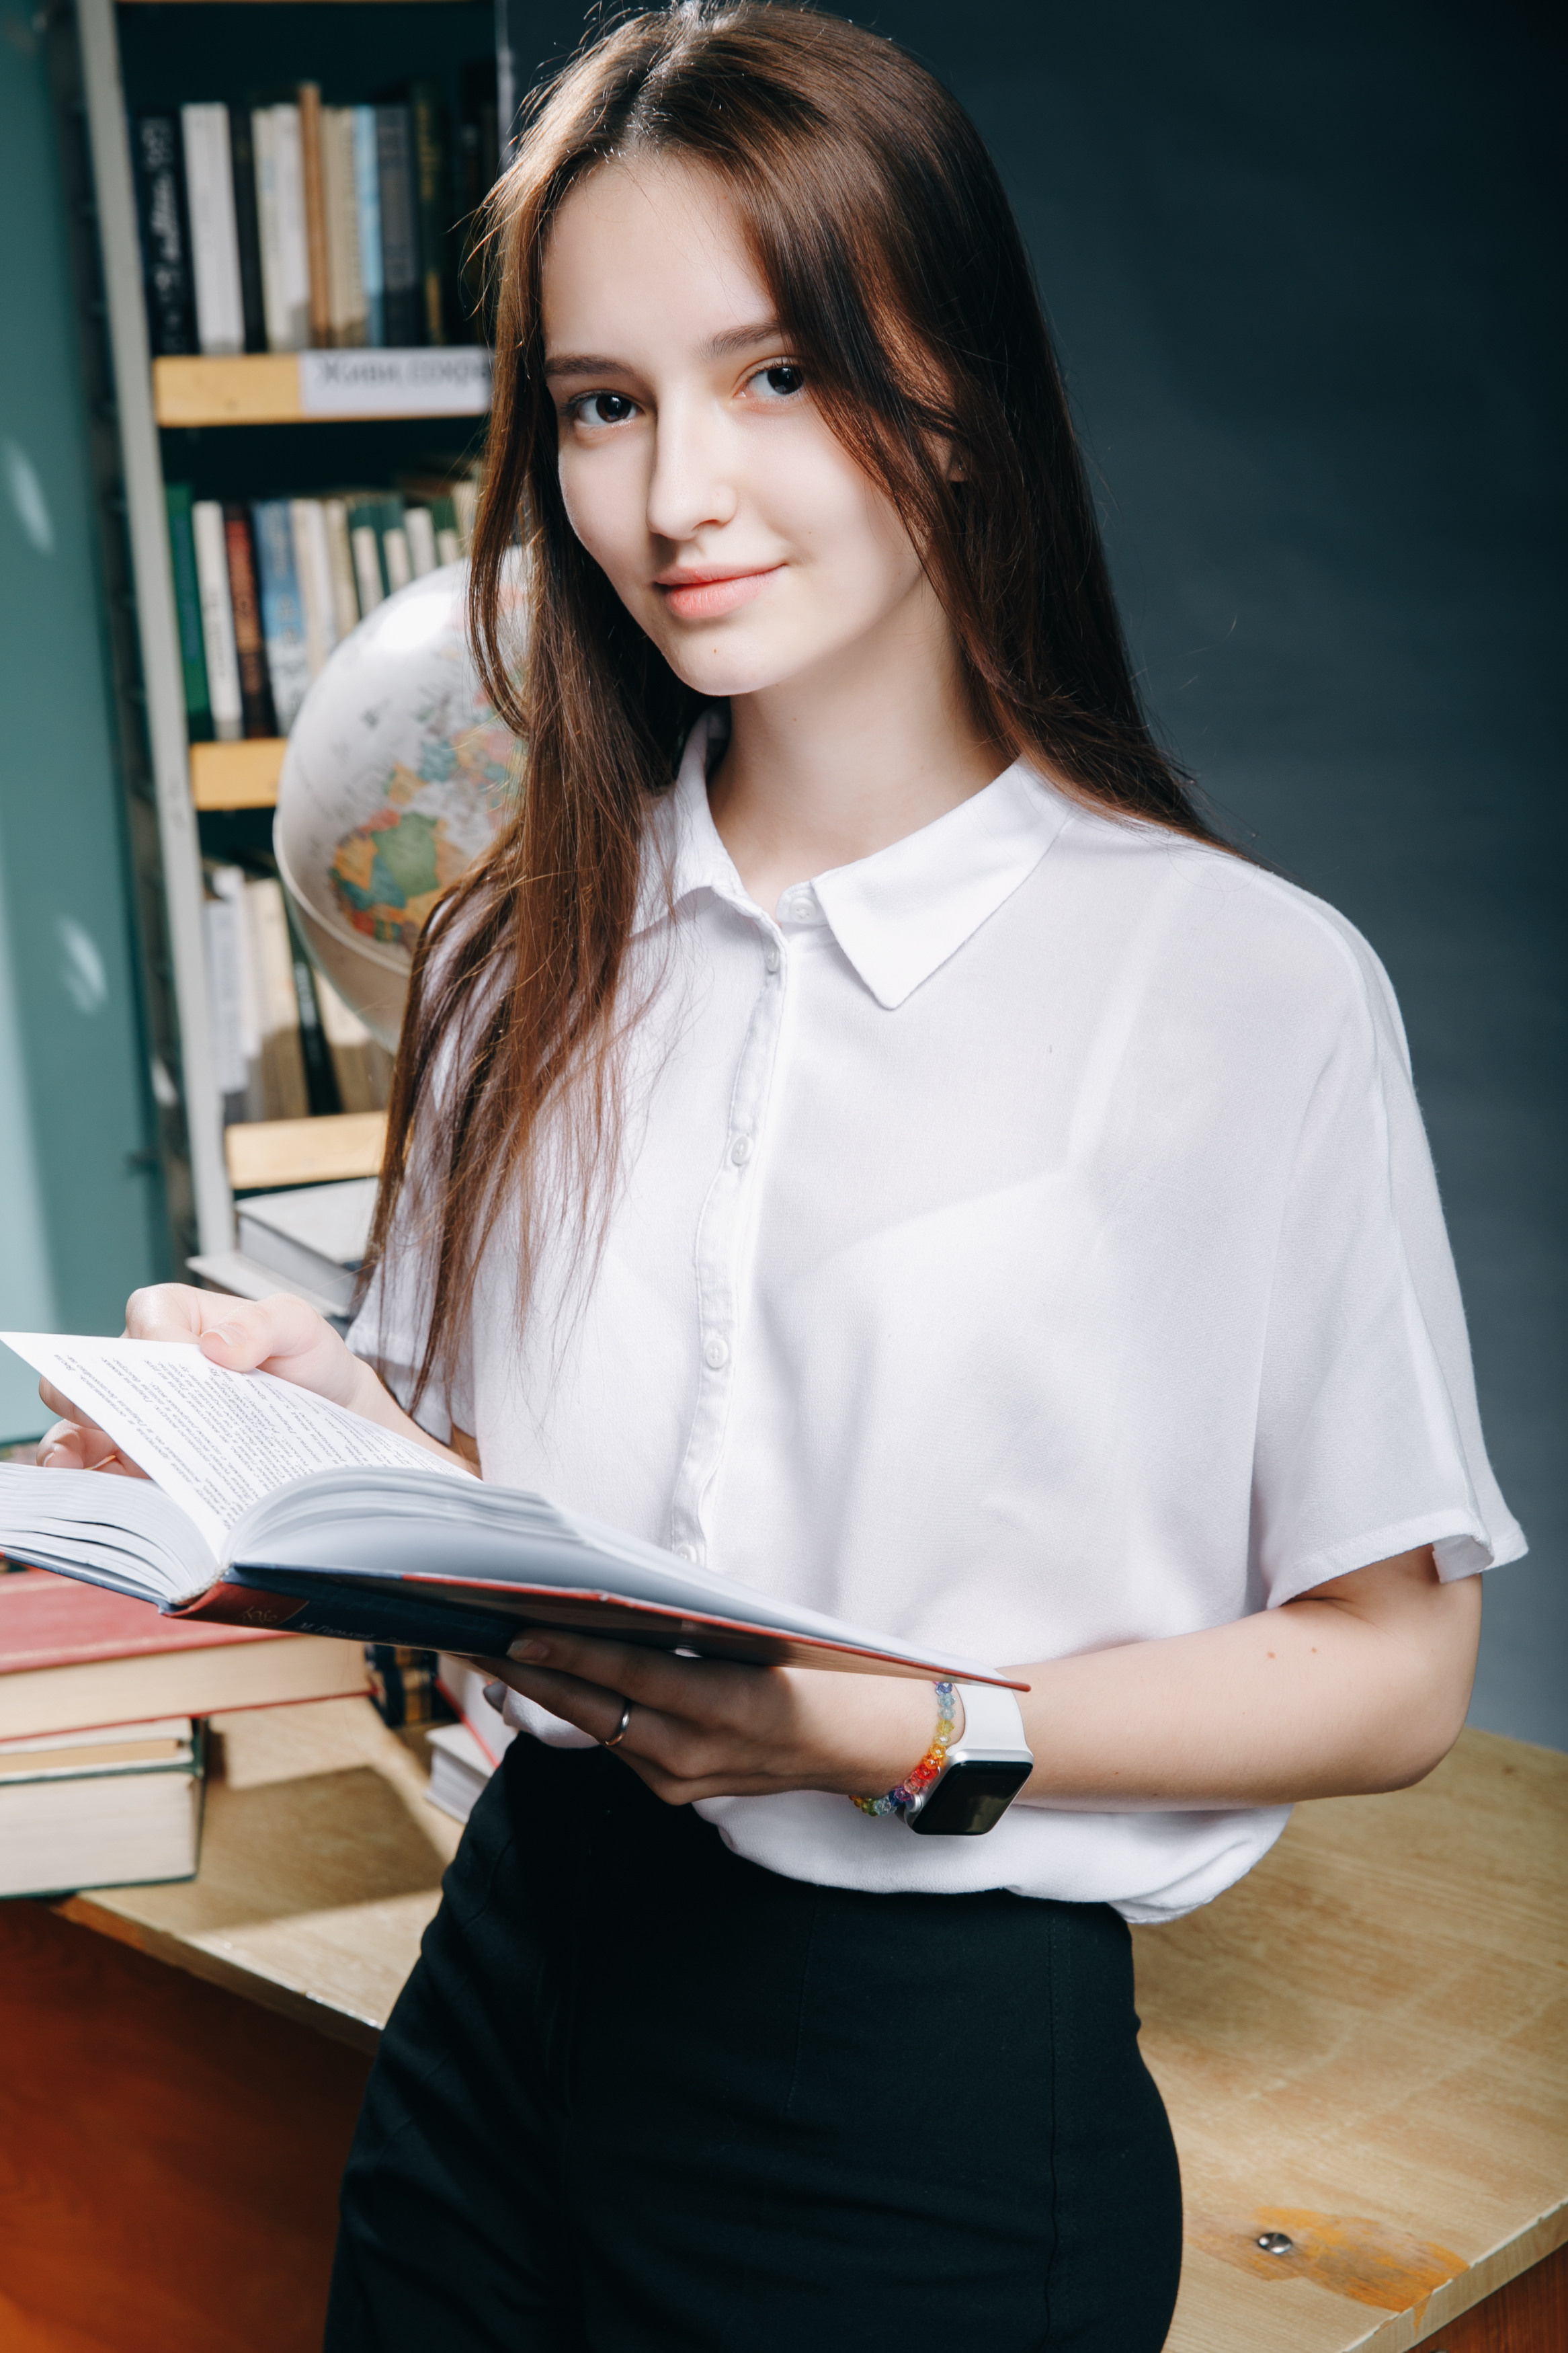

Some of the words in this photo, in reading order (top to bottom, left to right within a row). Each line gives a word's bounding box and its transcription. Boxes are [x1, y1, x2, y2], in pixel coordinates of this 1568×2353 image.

[77, 1365, 118, 1399] беспокойно
[123, 1378, 153, 1402] Гаврила
[140, 1384, 165, 1404] пошла
[80, 1375, 126, 1417] остановилась.
[117, 1400, 147, 1427] Гаврила
[316, 1626, 376, 1638] Горький
